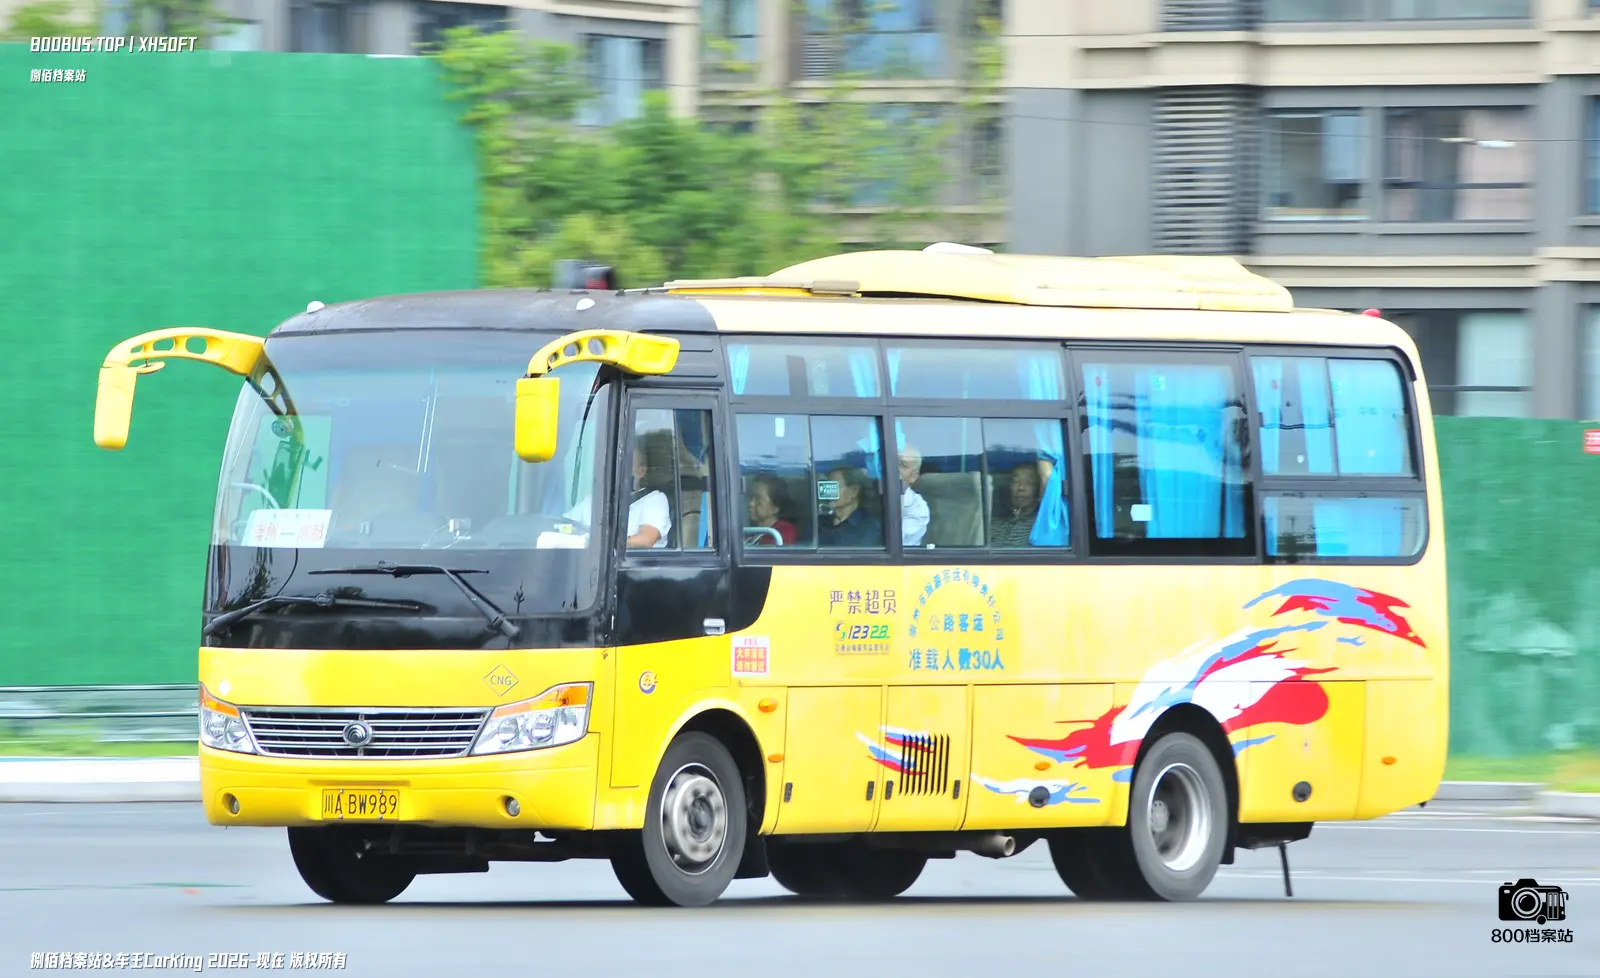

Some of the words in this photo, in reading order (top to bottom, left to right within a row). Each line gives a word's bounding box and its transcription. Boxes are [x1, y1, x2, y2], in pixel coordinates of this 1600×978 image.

[829, 589, 897, 615] 严禁超员
[847, 624, 889, 640] 12328
[929, 612, 984, 632] 公路客运
[908, 647, 1005, 671] 准载人数30人
[490, 675, 512, 686] CNG
